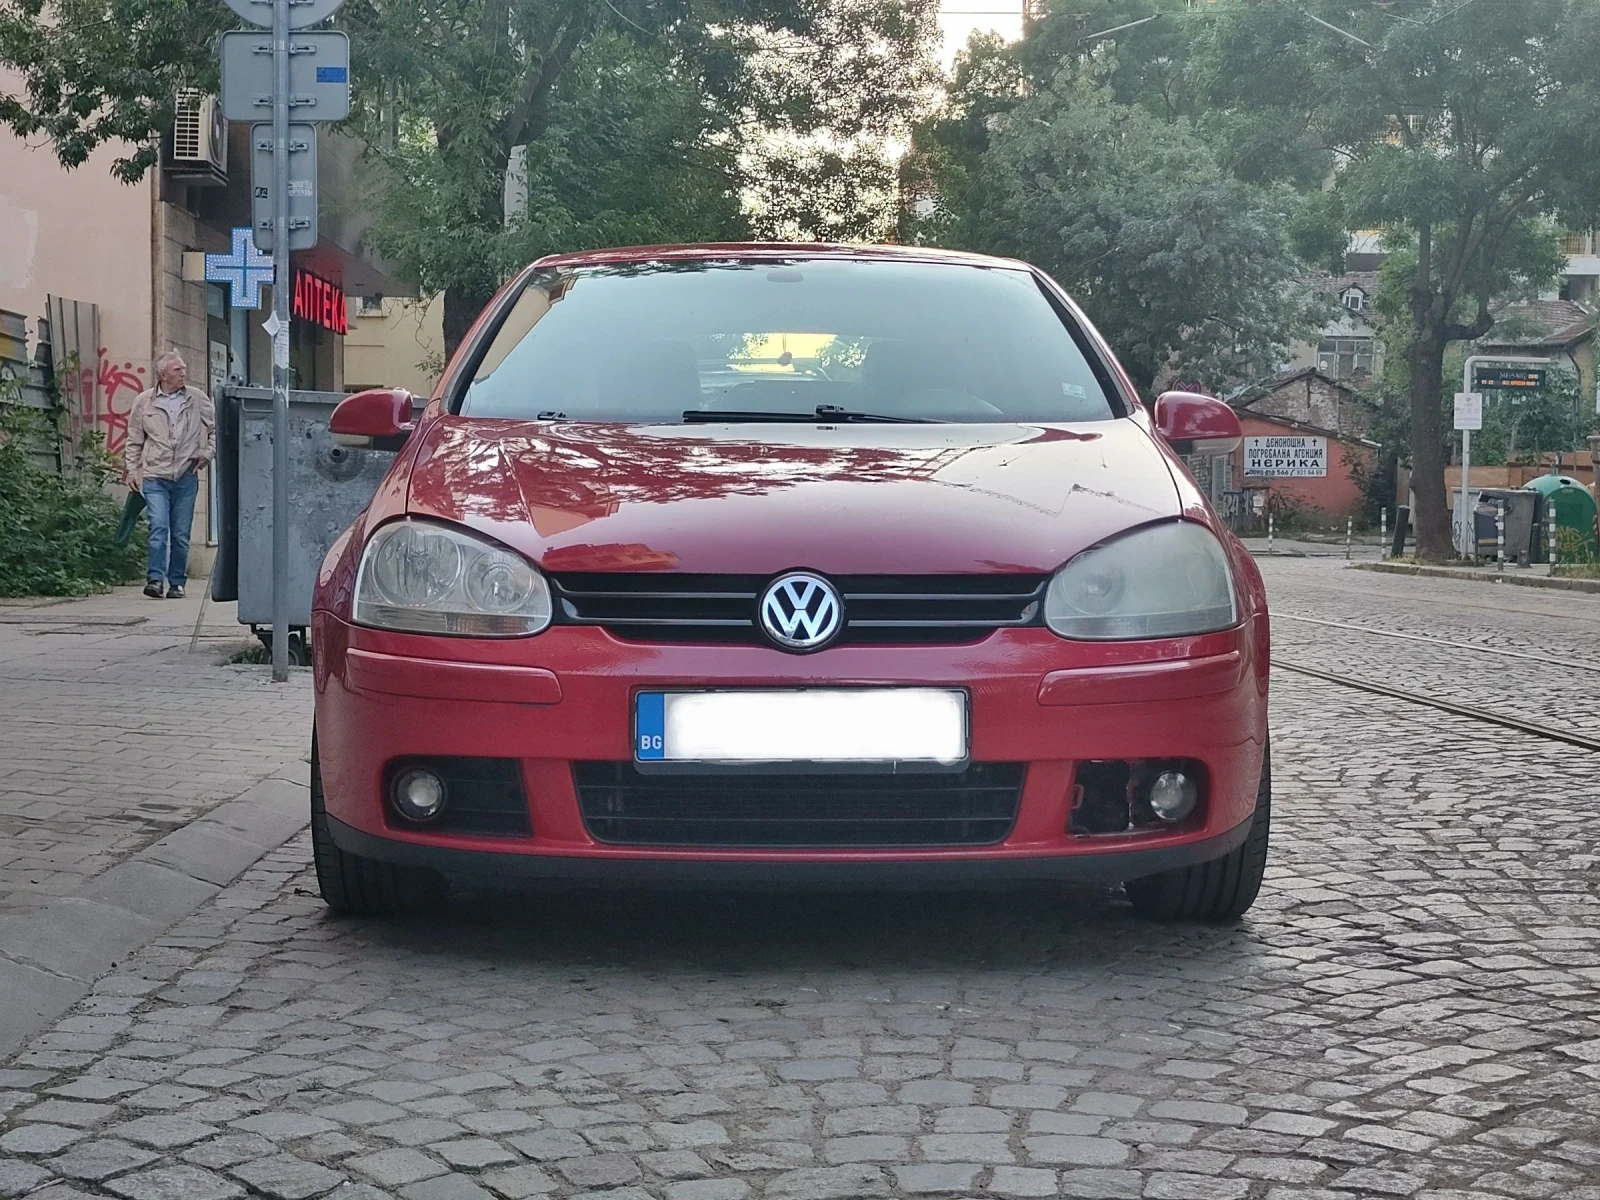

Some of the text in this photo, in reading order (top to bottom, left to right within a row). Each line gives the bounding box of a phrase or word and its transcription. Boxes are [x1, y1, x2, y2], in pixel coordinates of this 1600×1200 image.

[294, 269, 349, 336] АПТЕКА
[1293, 448, 1323, 459] АГЕНЦИЯ
[1251, 459, 1320, 468] НЕРИКА
[763, 575, 839, 645] VW
[641, 734, 662, 750] BG
